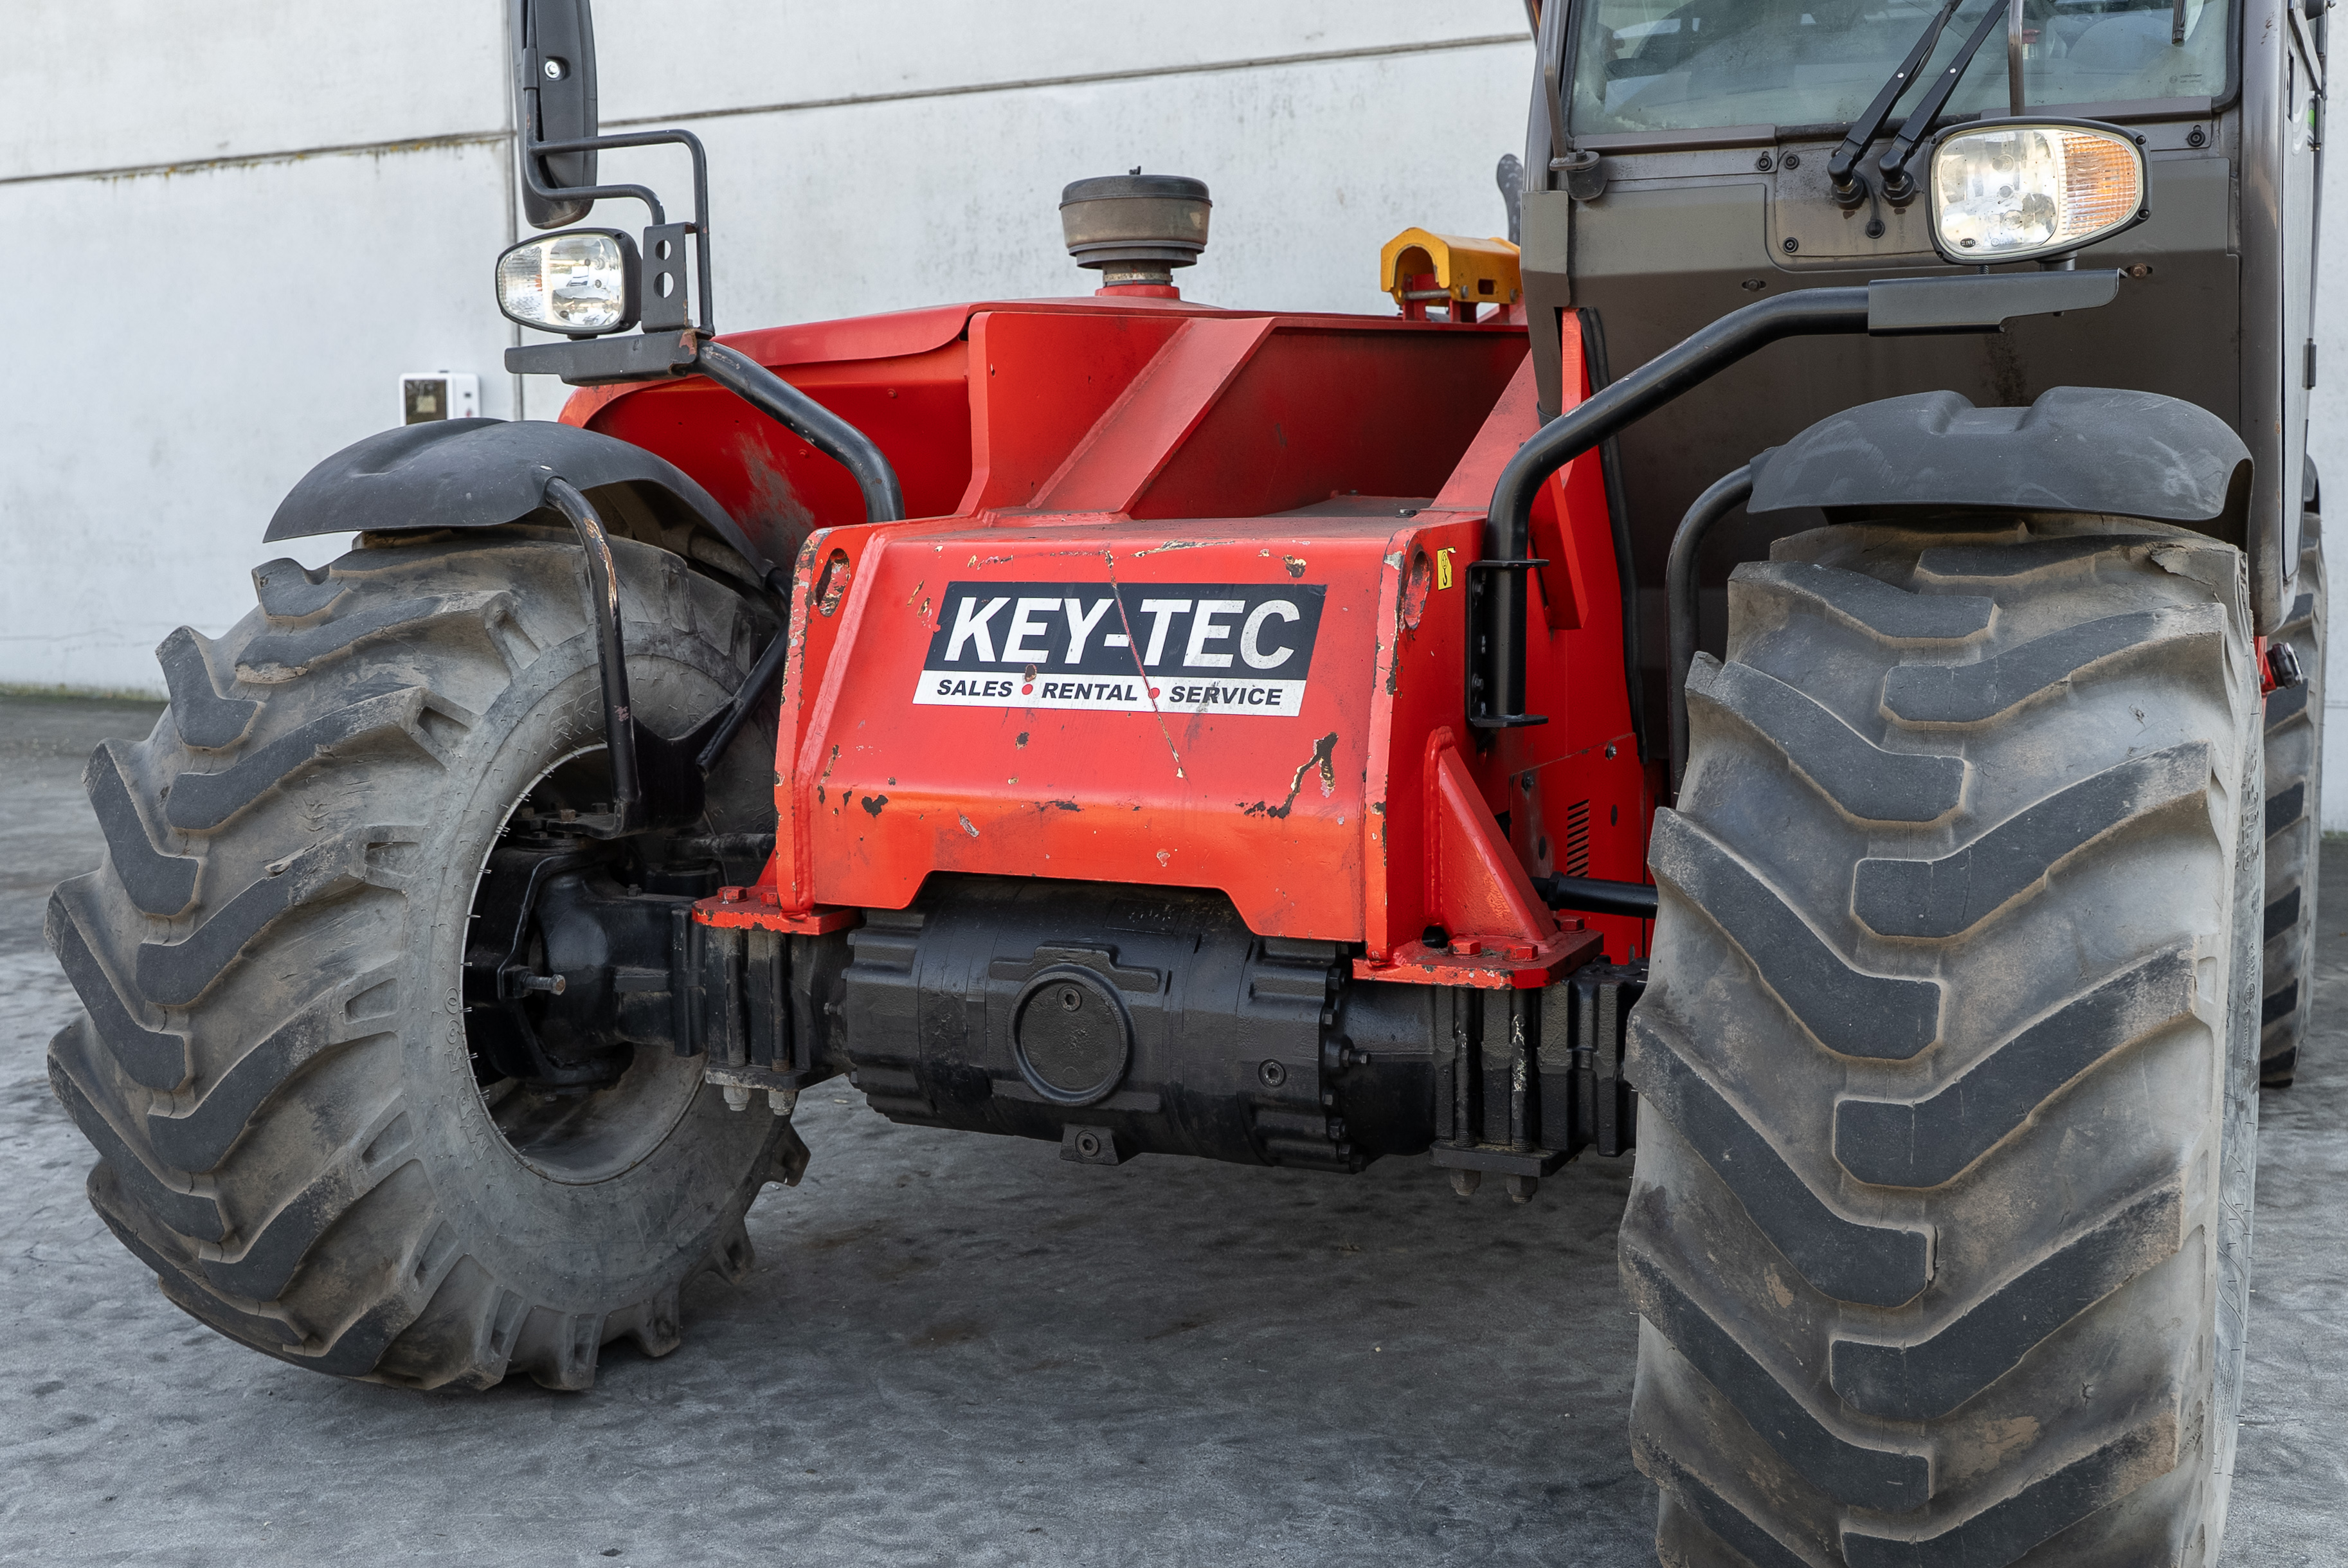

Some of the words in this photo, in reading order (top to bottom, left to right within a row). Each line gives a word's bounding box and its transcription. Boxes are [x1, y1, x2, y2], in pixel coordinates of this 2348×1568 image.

[944, 597, 1300, 669] KEY-TEC
[937, 679, 1013, 698] SALES
[1042, 682, 1138, 702] RENTAL
[1169, 686, 1283, 705] SERVICE
[444, 987, 465, 1073] 590
[456, 1086, 492, 1162] MP
